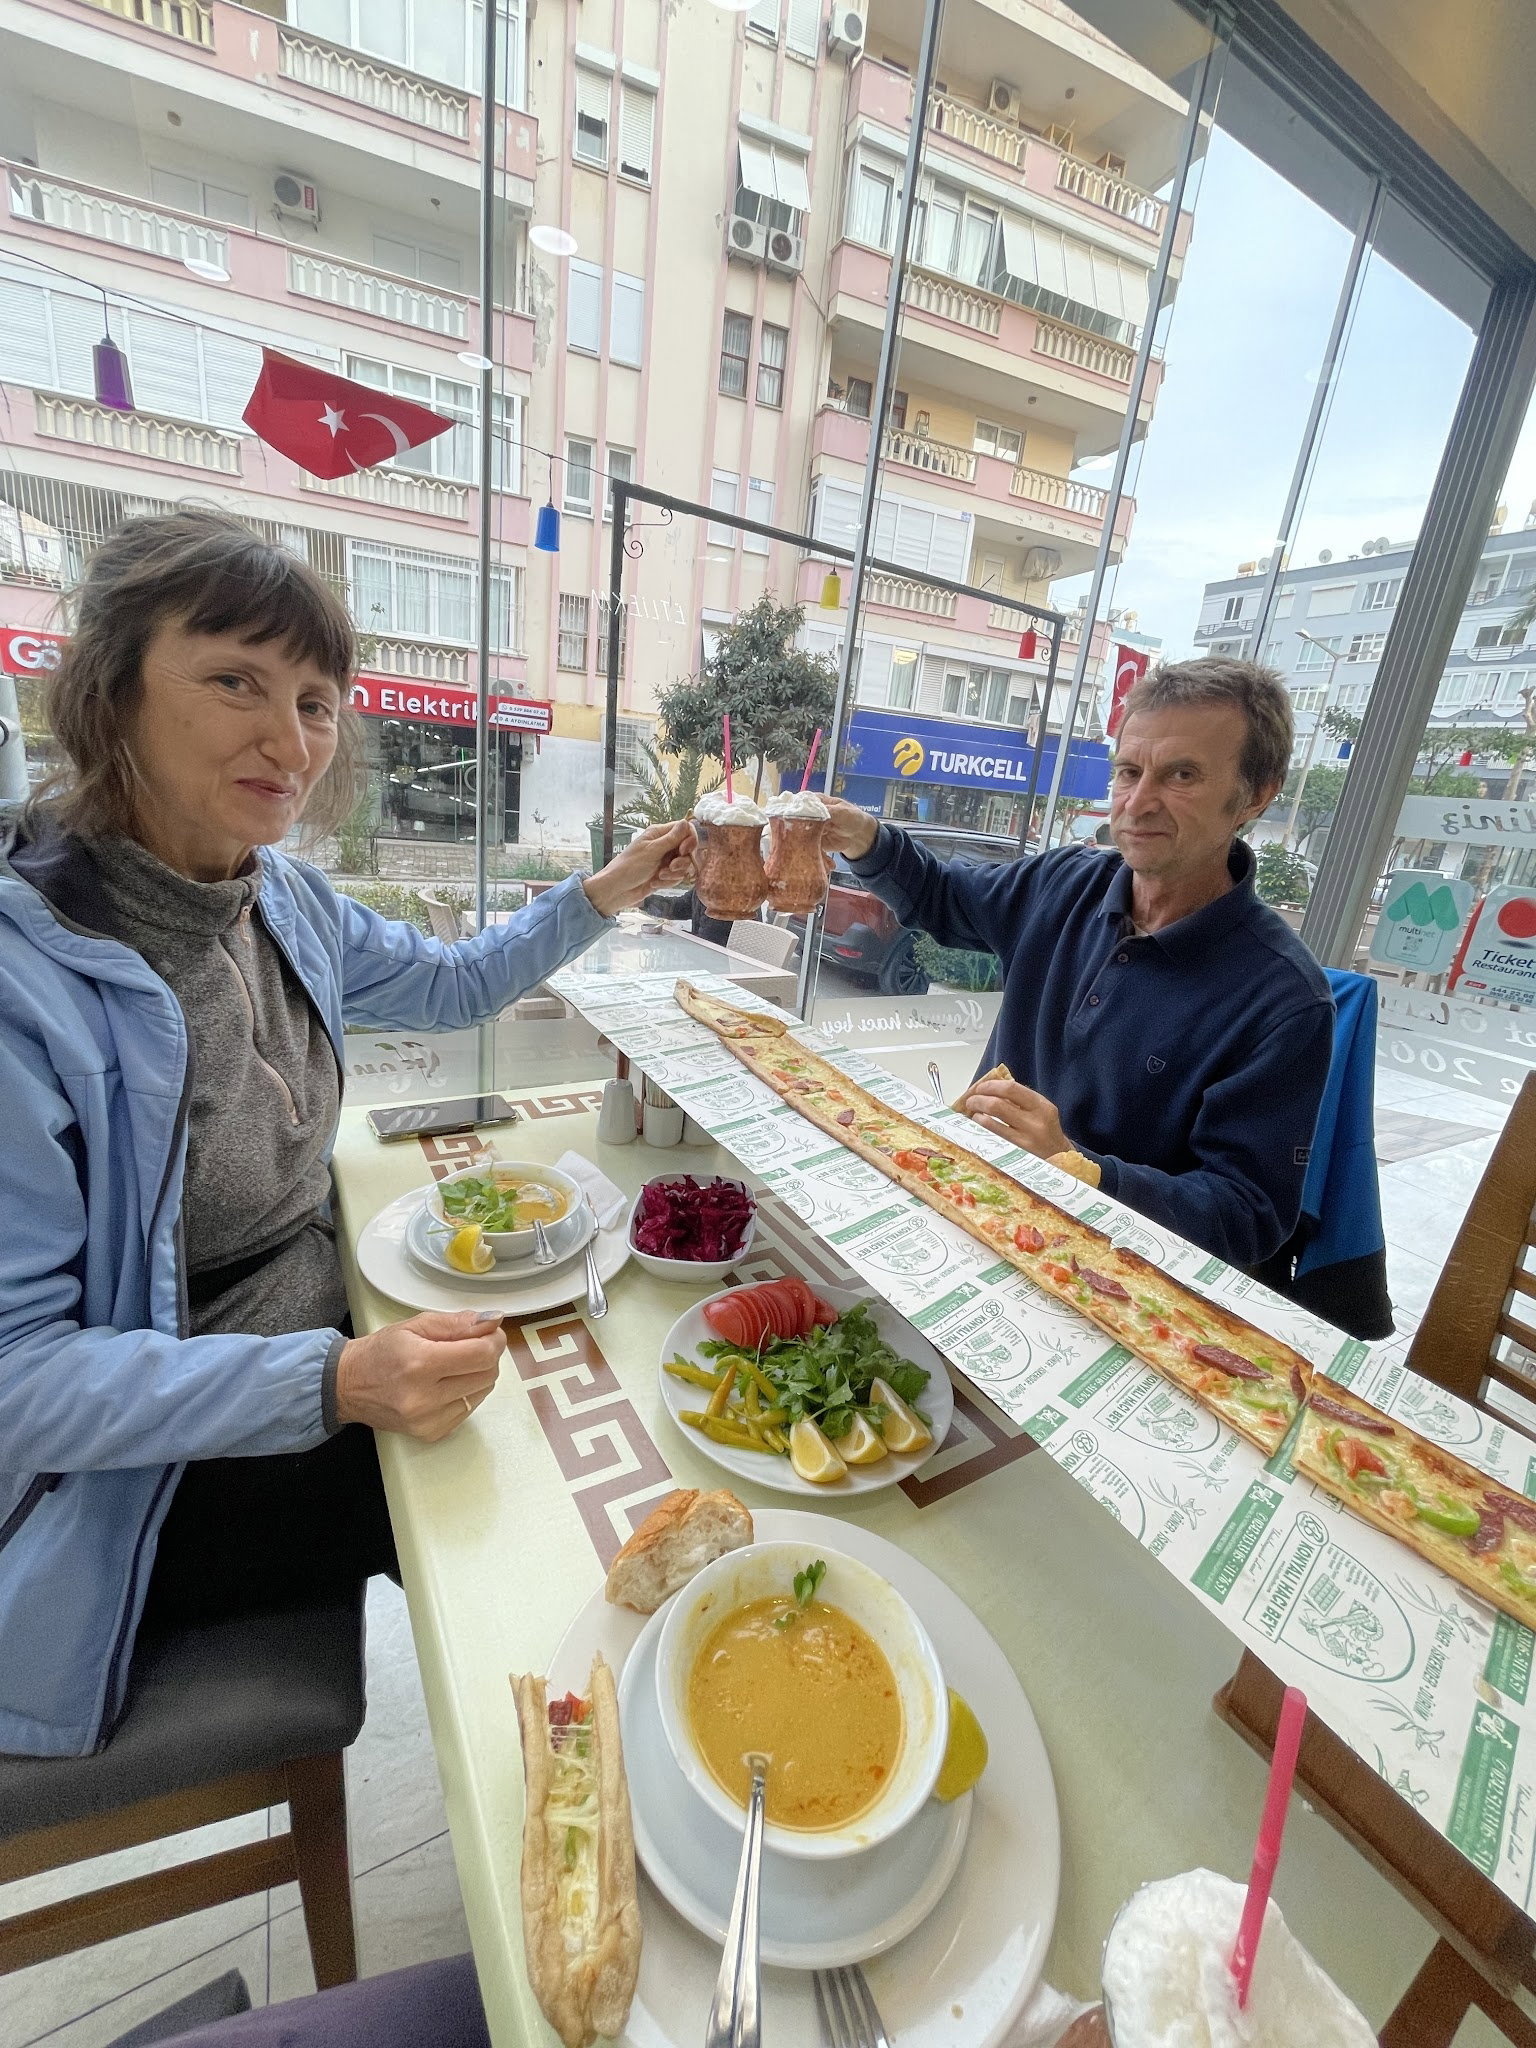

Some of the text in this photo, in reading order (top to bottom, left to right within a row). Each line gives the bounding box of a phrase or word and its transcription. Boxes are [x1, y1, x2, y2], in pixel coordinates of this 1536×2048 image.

[929, 750, 1027, 782] TURKCELL
[1483, 949, 1536, 969] Ticket
[1472, 960, 1536, 979] Restaurant
[884, 1225, 911, 1242] KONYALI
[855, 1247, 870, 1257] BEY
[868, 1239, 886, 1250] HACI
[1012, 1288, 1027, 1298] BEY
[955, 1314, 986, 1338] KONYALI
[940, 1333, 958, 1348] HACI
[1131, 1373, 1159, 1400] KONYALI
[1376, 1365, 1403, 1406] KONYALI HACI
[1116, 1395, 1136, 1414] HACI
[1105, 1409, 1123, 1426] BEY
[1147, 1510, 1186, 1557] DÖNER İSKEND
[1247, 1516, 1265, 1535] 0242
[1236, 1540, 1251, 1554] 33
[1241, 1529, 1257, 1546] 513
[1282, 1539, 1314, 1585] KONYALI
[1212, 1581, 1227, 1594] 57
[1217, 1572, 1232, 1586] 76
[1268, 1579, 1294, 1610] HACI
[1258, 1604, 1281, 1632] BEY
[1434, 1618, 1455, 1647] DÖNER
[1422, 1646, 1449, 1688] İSKENDER
